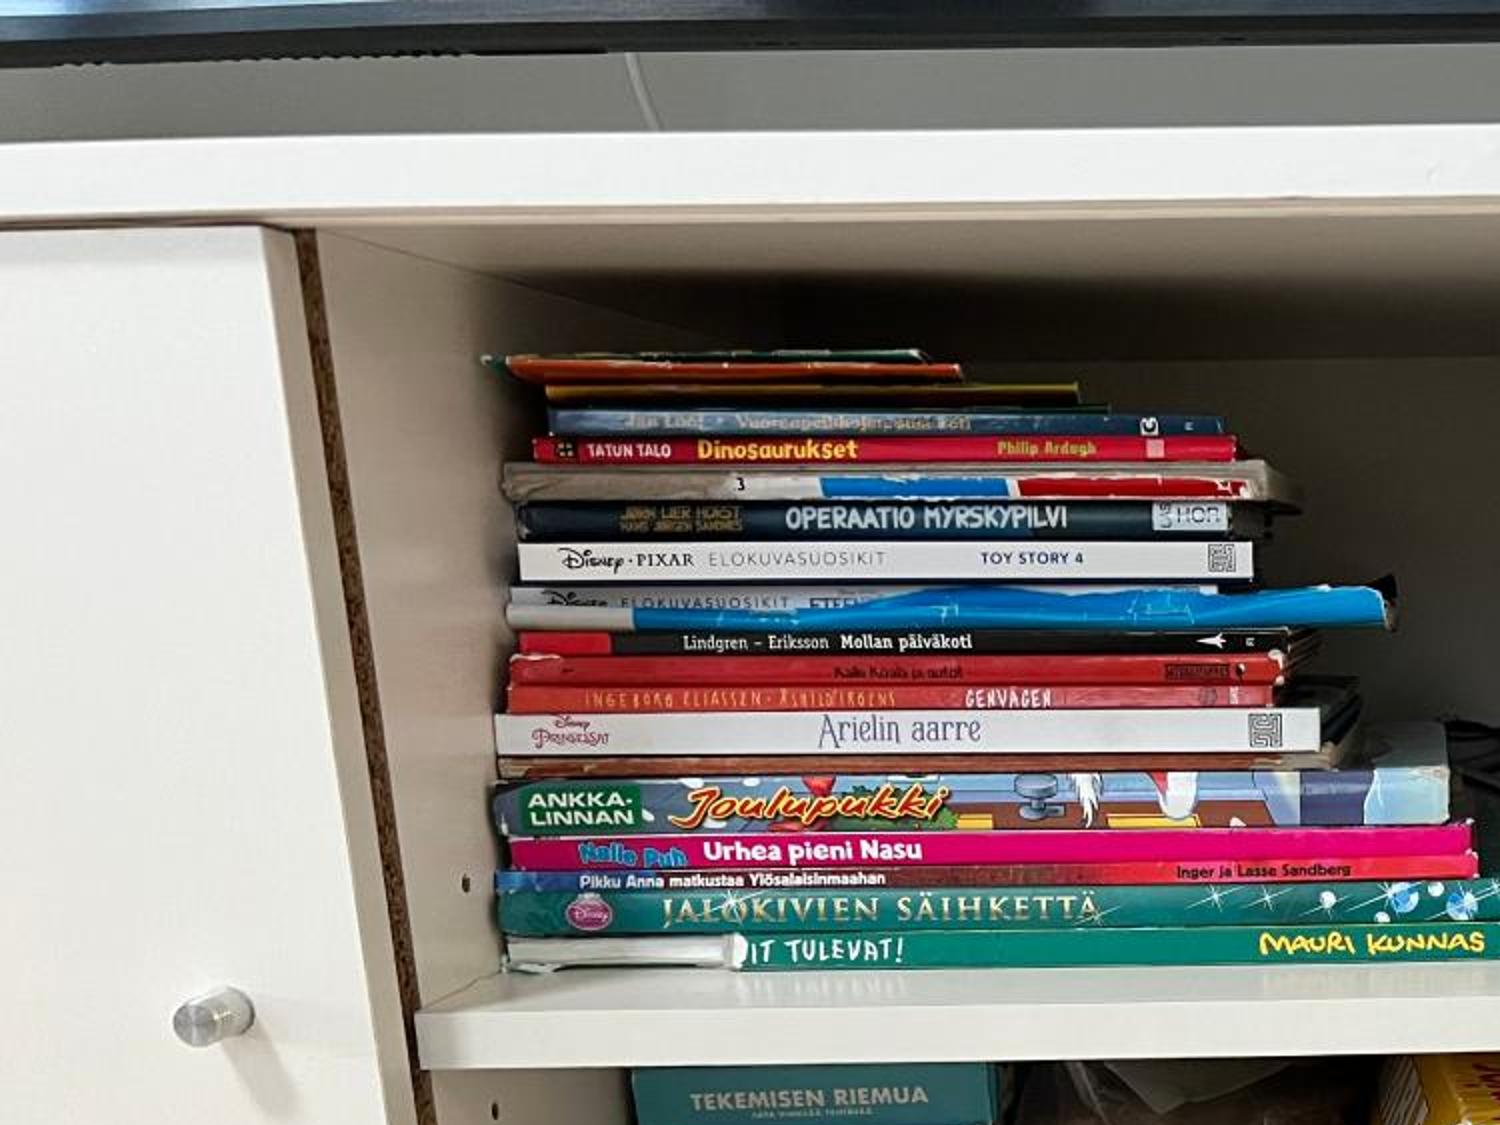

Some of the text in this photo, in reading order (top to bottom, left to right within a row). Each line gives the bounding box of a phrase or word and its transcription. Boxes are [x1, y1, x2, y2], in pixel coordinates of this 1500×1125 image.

[587, 443, 632, 459] TATUN
[636, 443, 672, 459] TALO
[697, 439, 859, 460] Dinosaurukset
[997, 441, 1038, 456] Philip
[736, 477, 745, 491] 3
[785, 505, 1068, 530] OPERAATIO MYRSKYPILVI
[557, 548, 1084, 574] Disney PIXAR ELOKUVASUOSIKIT TOY STORY 4
[683, 634, 973, 653] Lindgren Eriksson Mollan päiväkoti
[818, 714, 982, 749] Arielin aarre
[527, 791, 633, 809] ANKKA-
[668, 784, 951, 830] Joulupukki
[530, 809, 634, 826] LINNAN
[703, 841, 782, 861] Urhea
[787, 840, 853, 866] pieni
[859, 839, 923, 861] Nasu
[579, 862, 1352, 889] Pikku Anna matkustaa Ylösalaisinmaahan Inger ja Lasse Sandberg
[661, 891, 1098, 928] JALOKIVIEN SÄIHKETTÄ
[784, 937, 904, 963] TULEVAT!
[1259, 931, 1354, 954] MAURI
[1367, 930, 1486, 953] KUNNAS
[689, 1085, 929, 1111] TEKEMISEN RIEMUA
